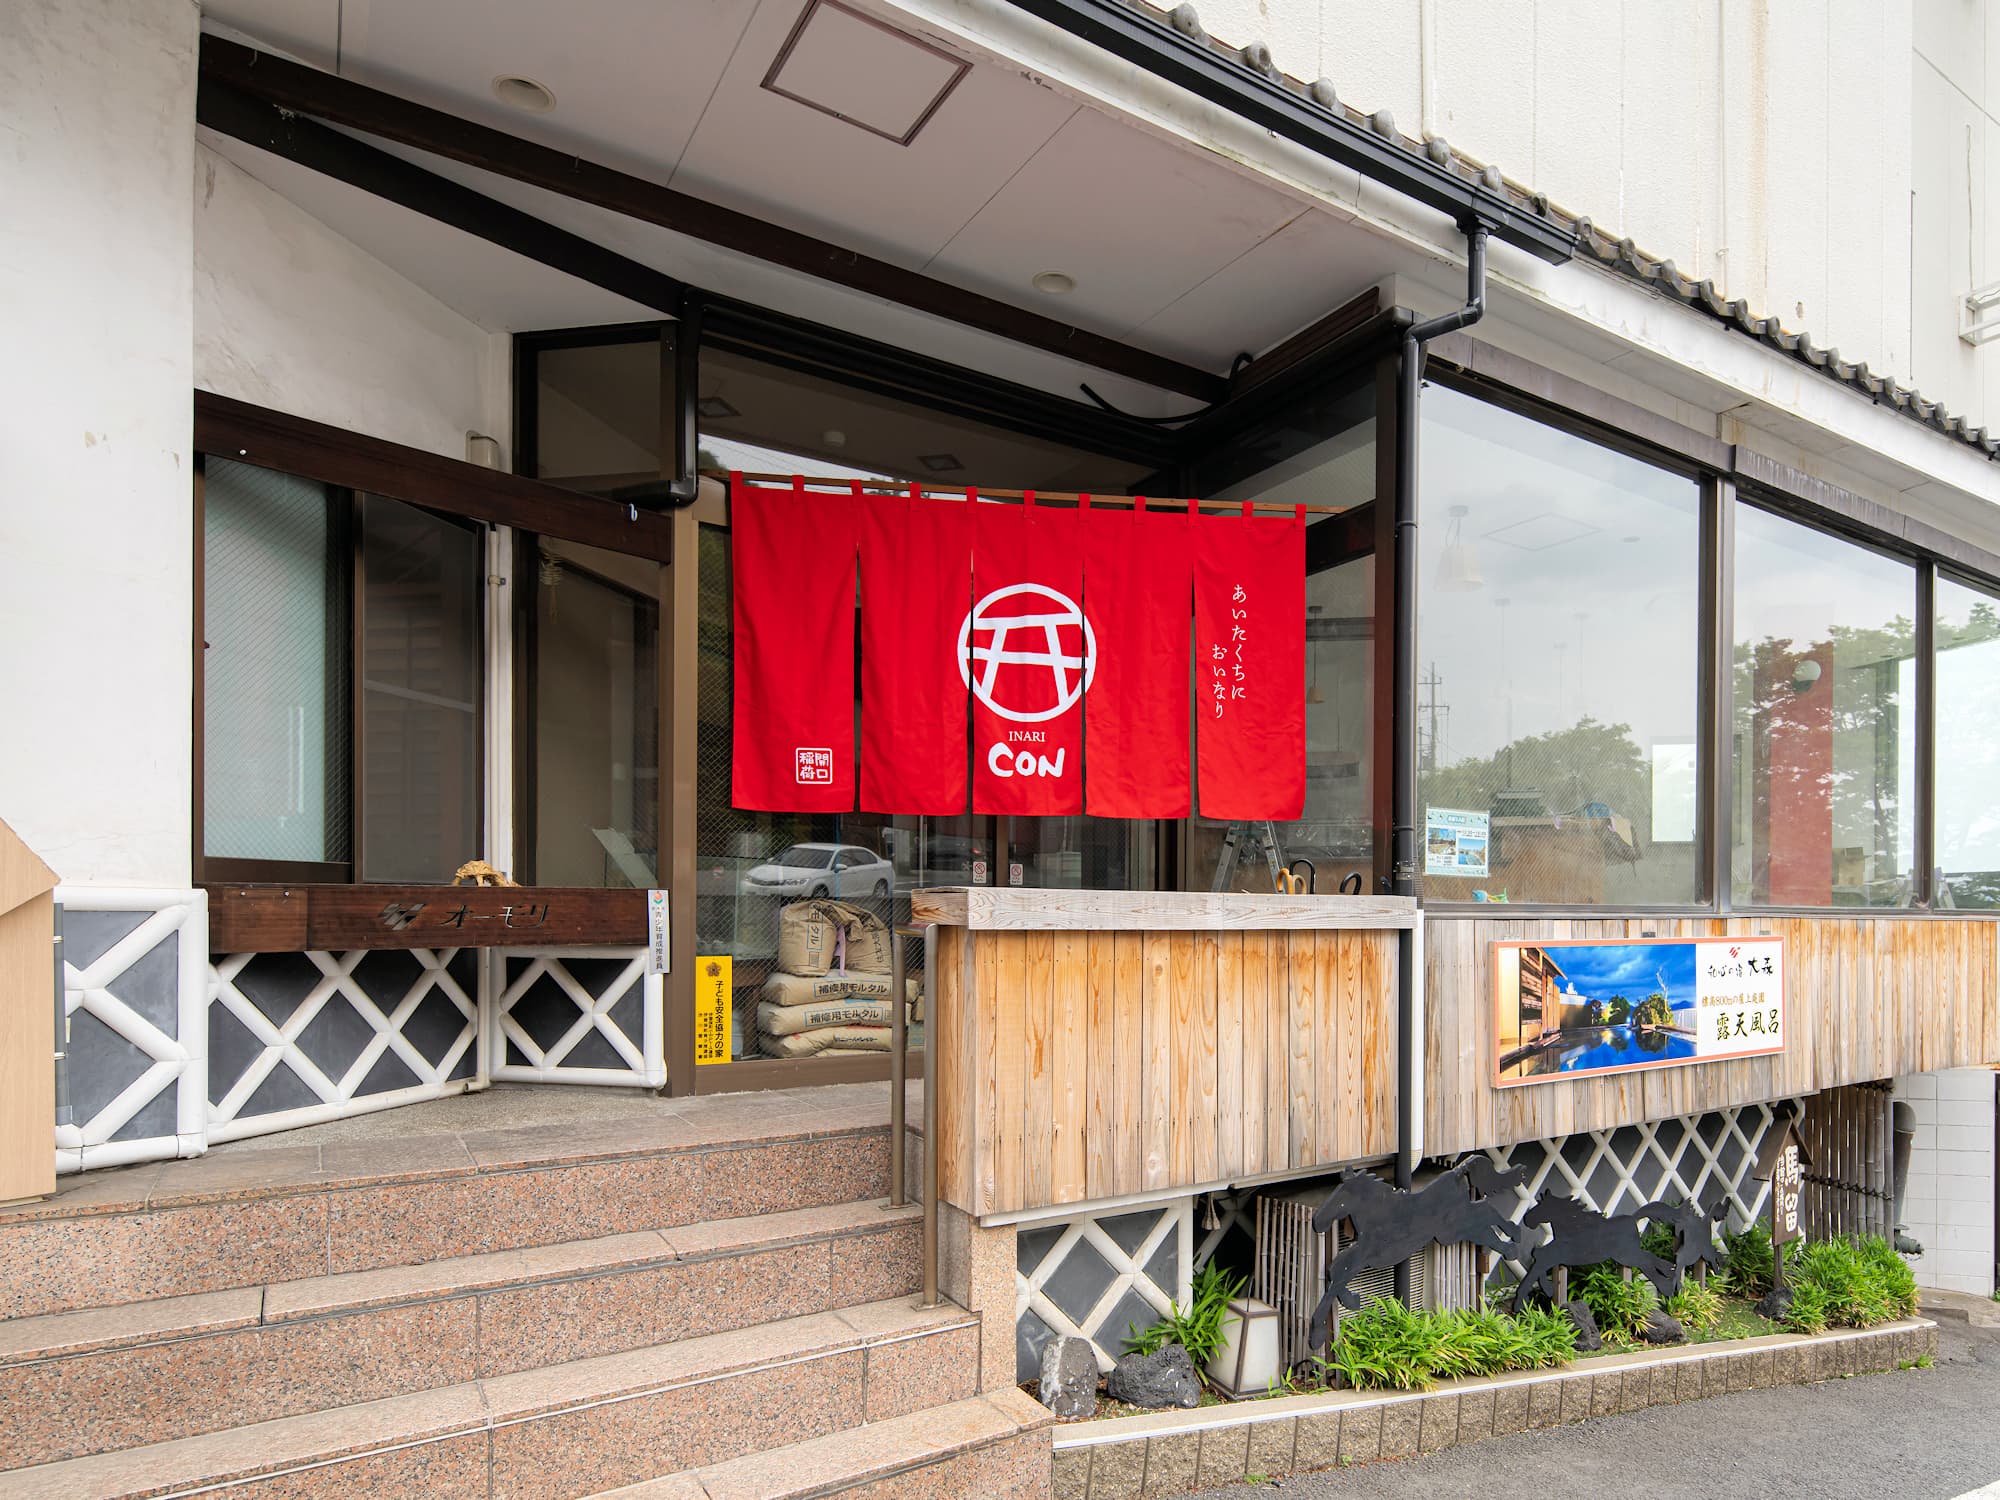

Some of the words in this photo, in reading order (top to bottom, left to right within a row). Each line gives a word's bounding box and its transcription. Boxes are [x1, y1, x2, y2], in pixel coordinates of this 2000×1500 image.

[1231, 584, 1247, 700] あいたくちに
[1212, 644, 1228, 719] おいなり
[1008, 731, 1045, 743] INARI
[988, 742, 1066, 778] CON
[437, 904, 549, 929] オーモリ
[818, 982, 888, 995] 補修用モルタル
[714, 980, 724, 1058] 子ども安全協力の家
[810, 1009, 879, 1024] 補修用モルタル
[1716, 1009, 1779, 1041] 露天風呂
